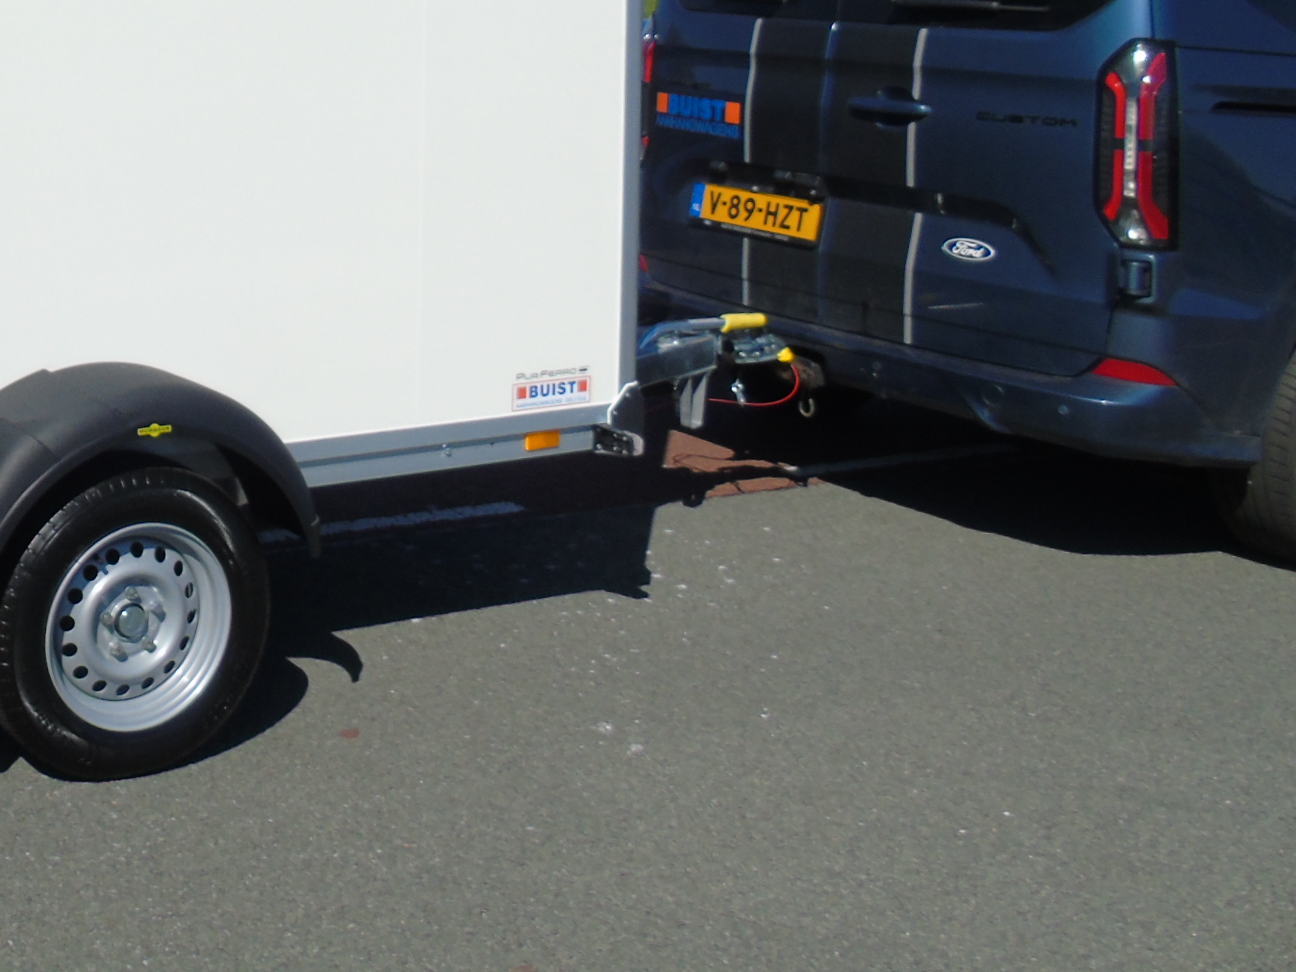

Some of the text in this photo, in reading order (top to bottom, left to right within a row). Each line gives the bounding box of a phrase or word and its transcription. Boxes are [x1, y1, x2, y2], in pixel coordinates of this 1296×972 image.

[668, 93, 726, 122] BUIST
[975, 110, 1078, 127] CUSTOM
[709, 190, 809, 232] V-89-HZT
[952, 240, 985, 258] Ford
[529, 380, 576, 398] BUIST
